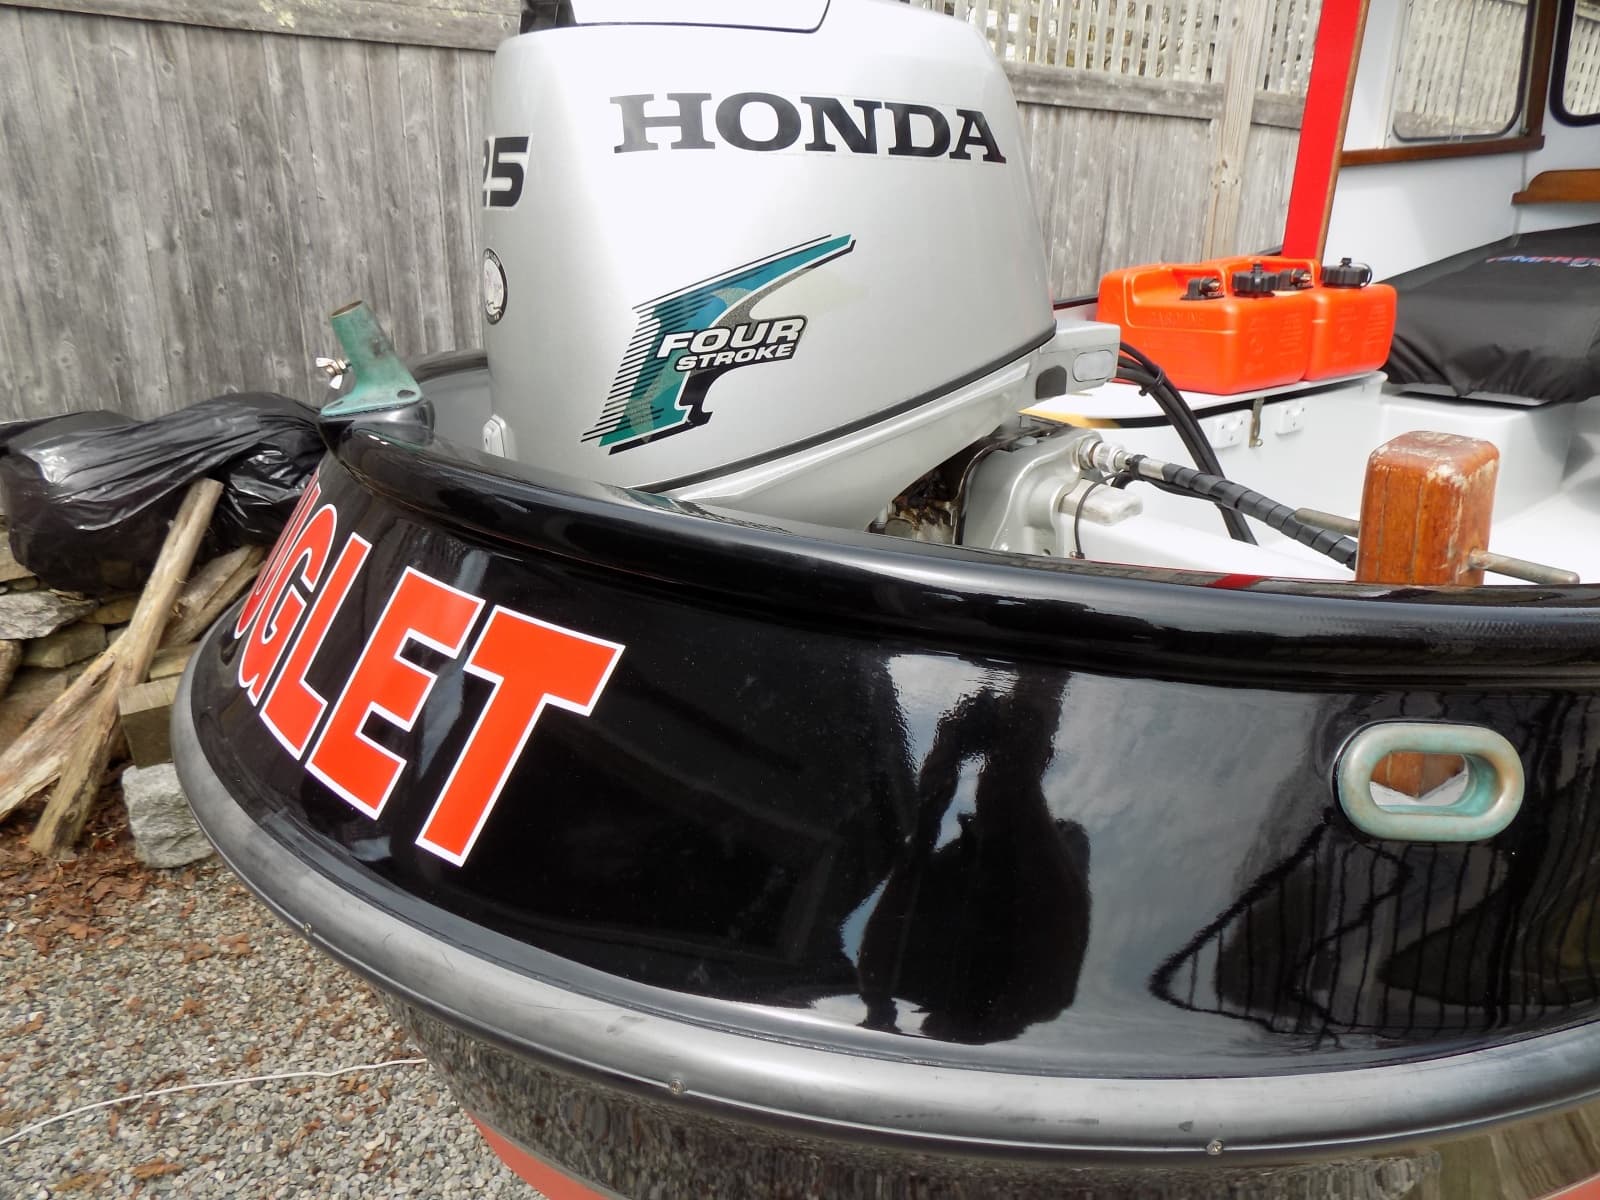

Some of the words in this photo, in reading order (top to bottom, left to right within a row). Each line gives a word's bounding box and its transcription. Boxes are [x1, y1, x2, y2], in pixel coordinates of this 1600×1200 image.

[609, 92, 1007, 164] HONDA
[656, 318, 805, 359] FOUR
[676, 342, 795, 371] STROKE
